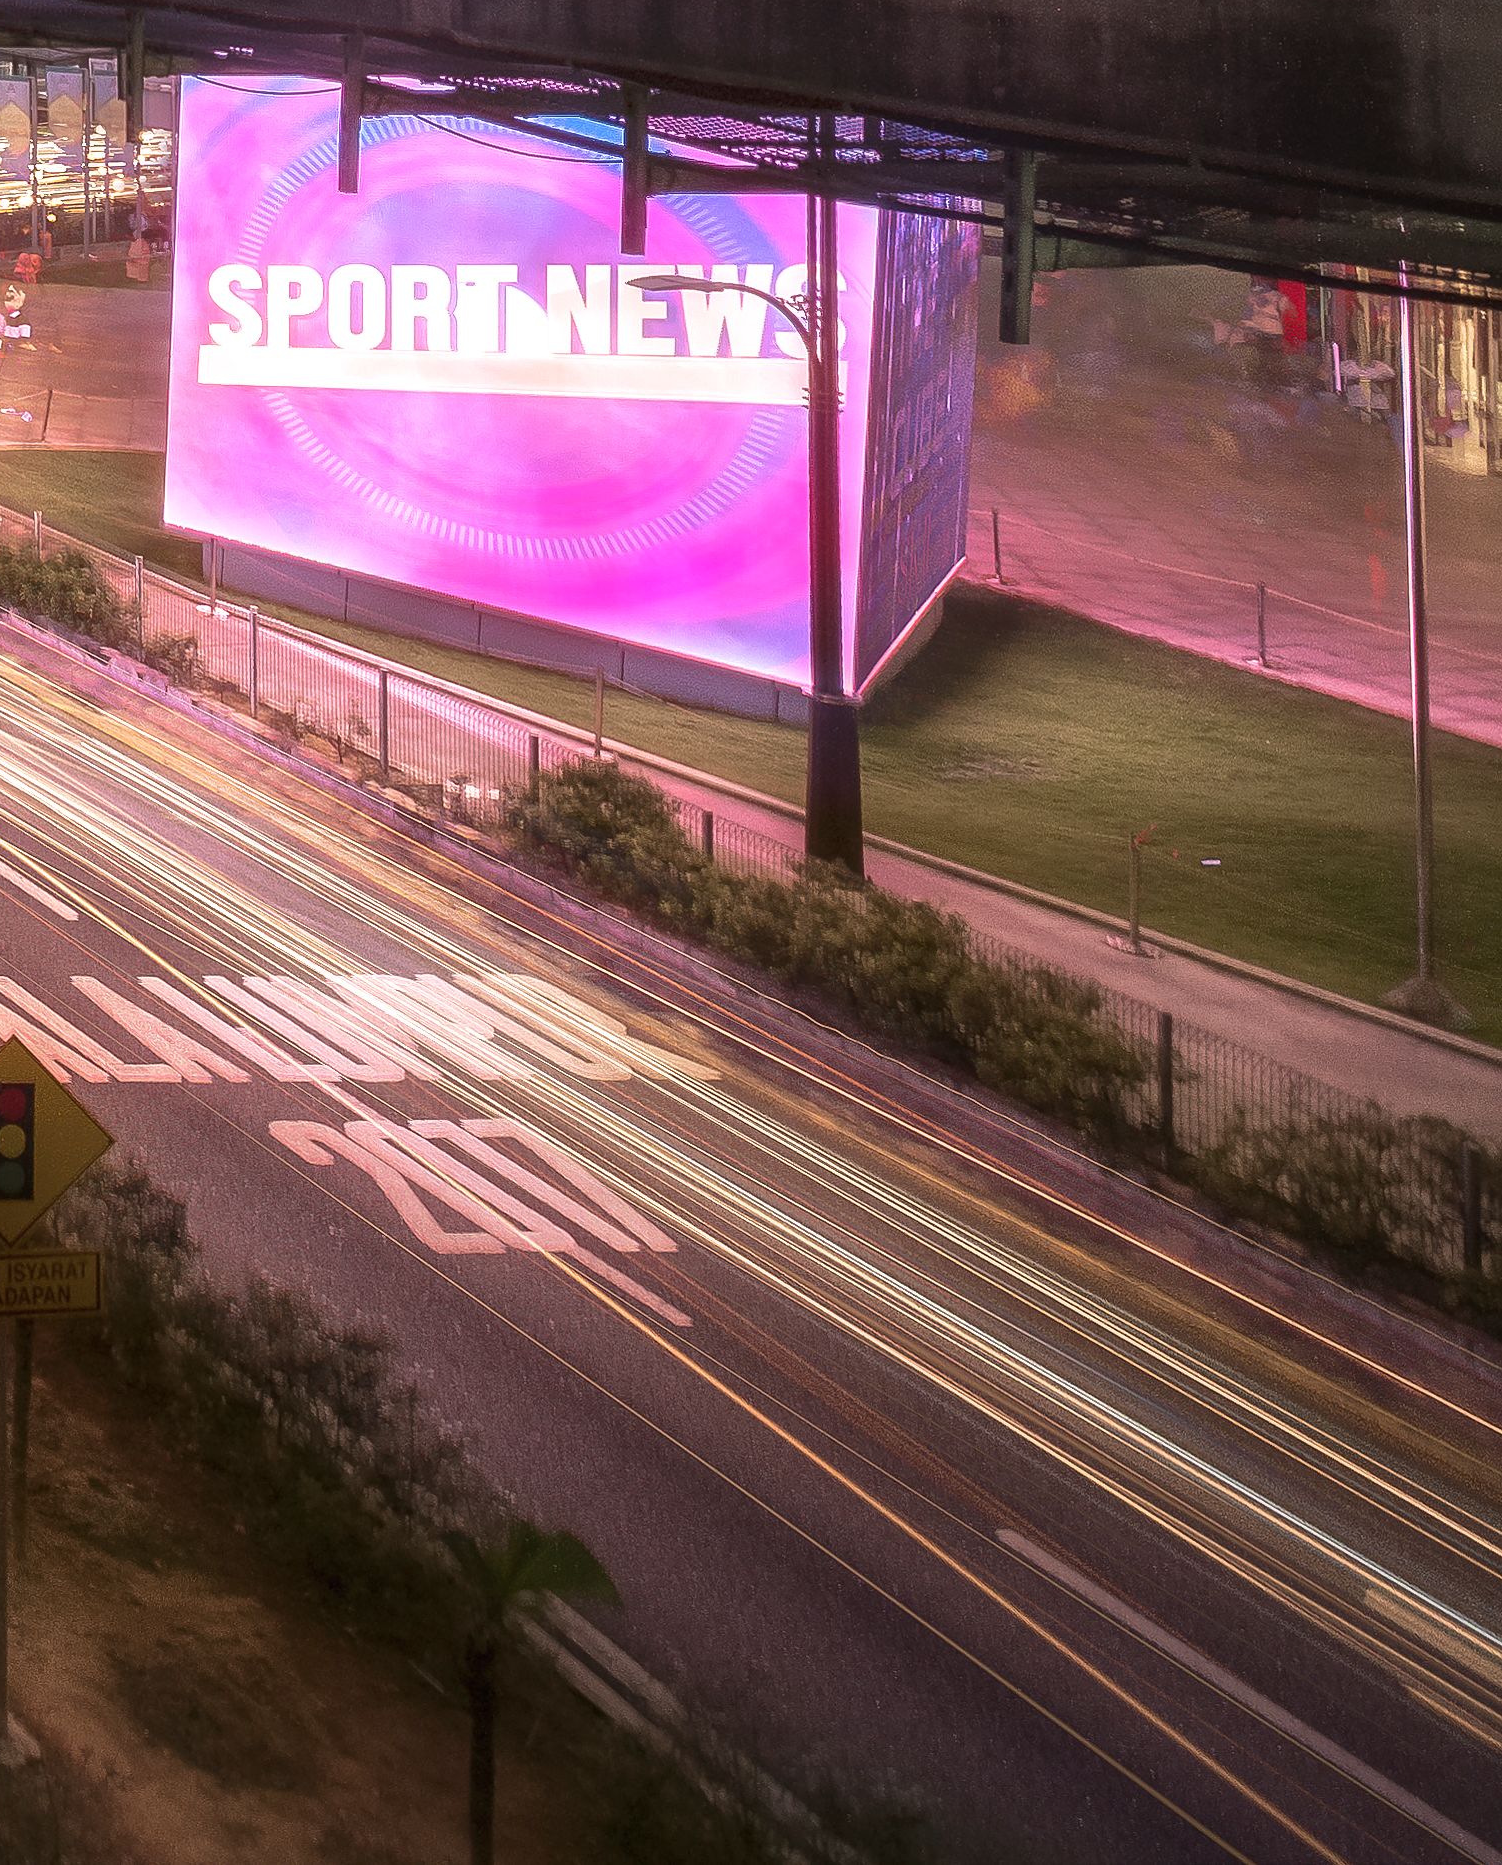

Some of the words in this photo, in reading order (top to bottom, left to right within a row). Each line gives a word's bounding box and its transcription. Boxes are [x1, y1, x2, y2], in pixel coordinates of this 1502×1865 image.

[207, 262, 521, 355] SPORT
[546, 263, 849, 360] NEWS
[7, 1261, 88, 1281] ISYARAT
